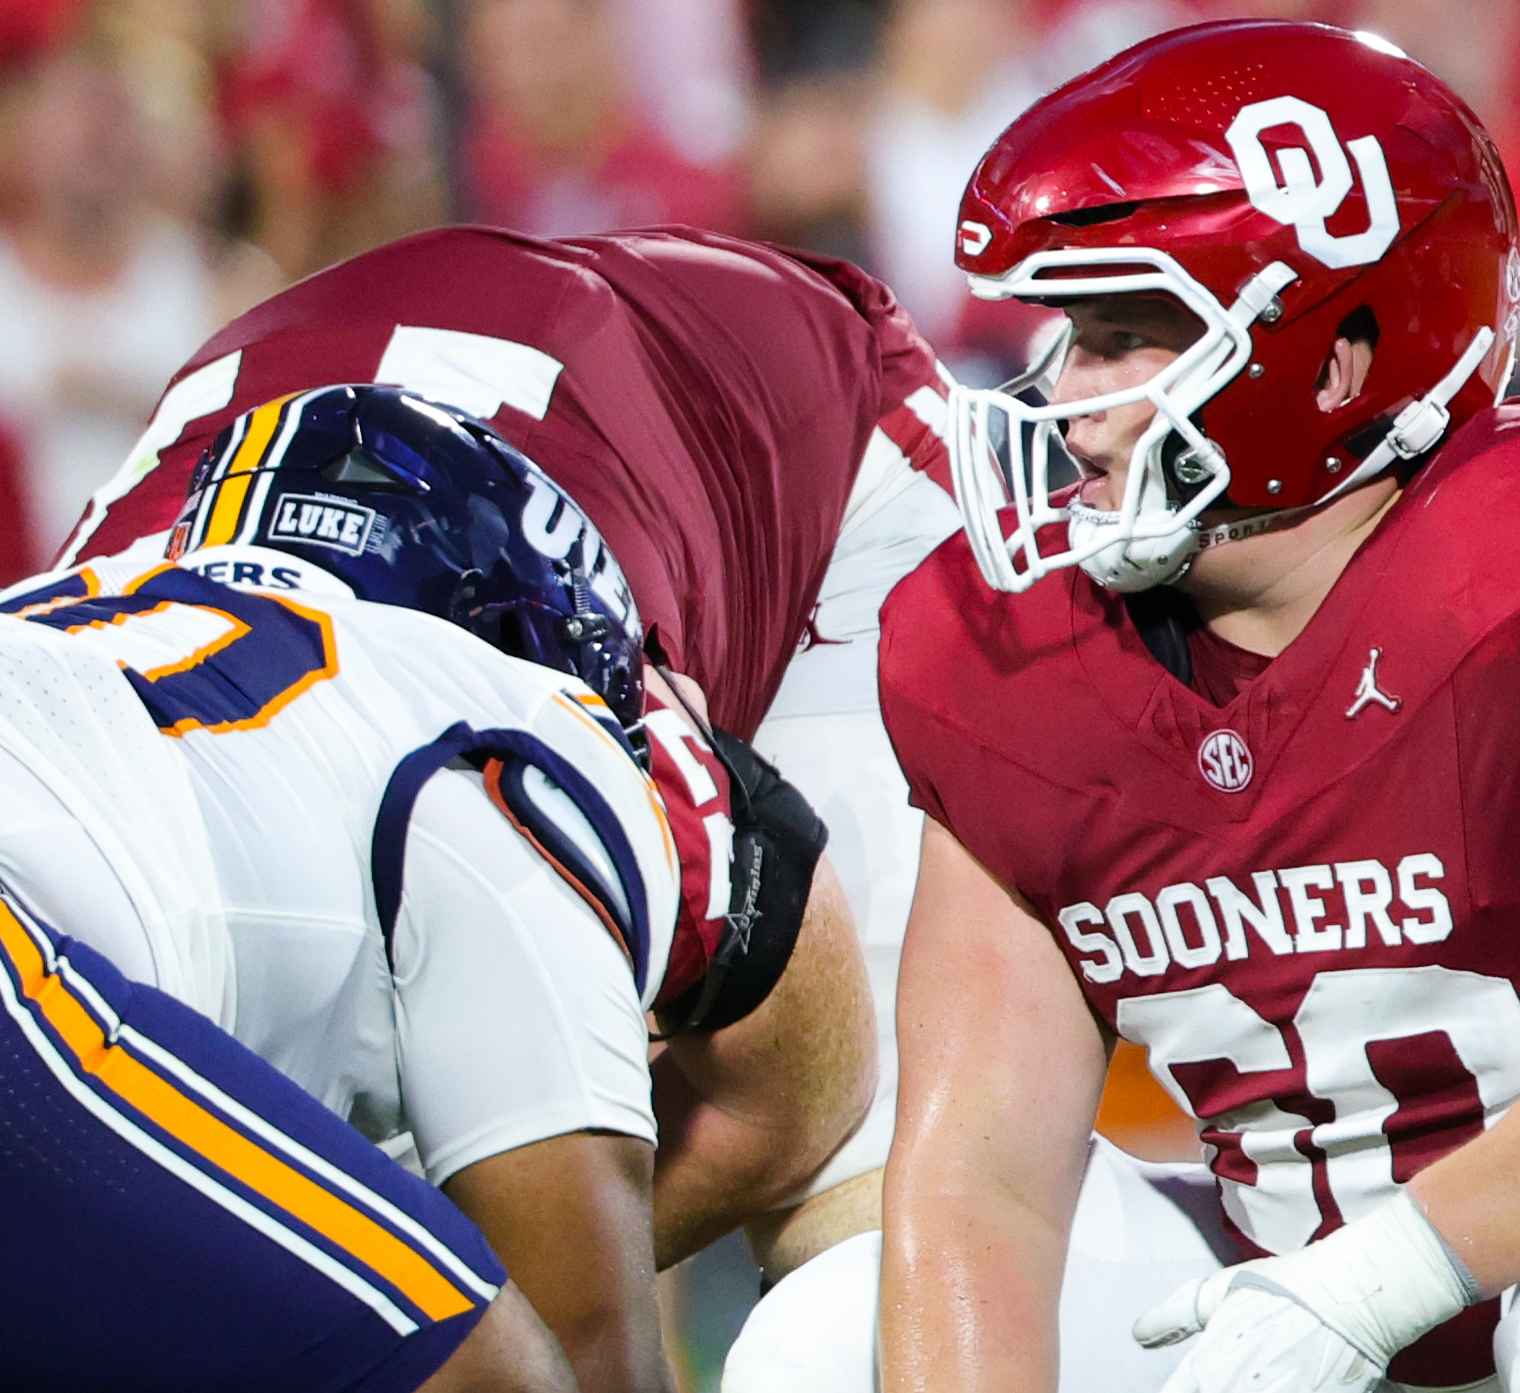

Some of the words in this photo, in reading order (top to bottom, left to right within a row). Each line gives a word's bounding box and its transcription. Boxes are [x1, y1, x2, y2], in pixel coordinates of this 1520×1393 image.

[1224, 94, 1401, 270] OU
[277, 501, 365, 544] LUKE
[1203, 733, 1249, 788] SEC
[1057, 852, 1456, 985] SOONERS
